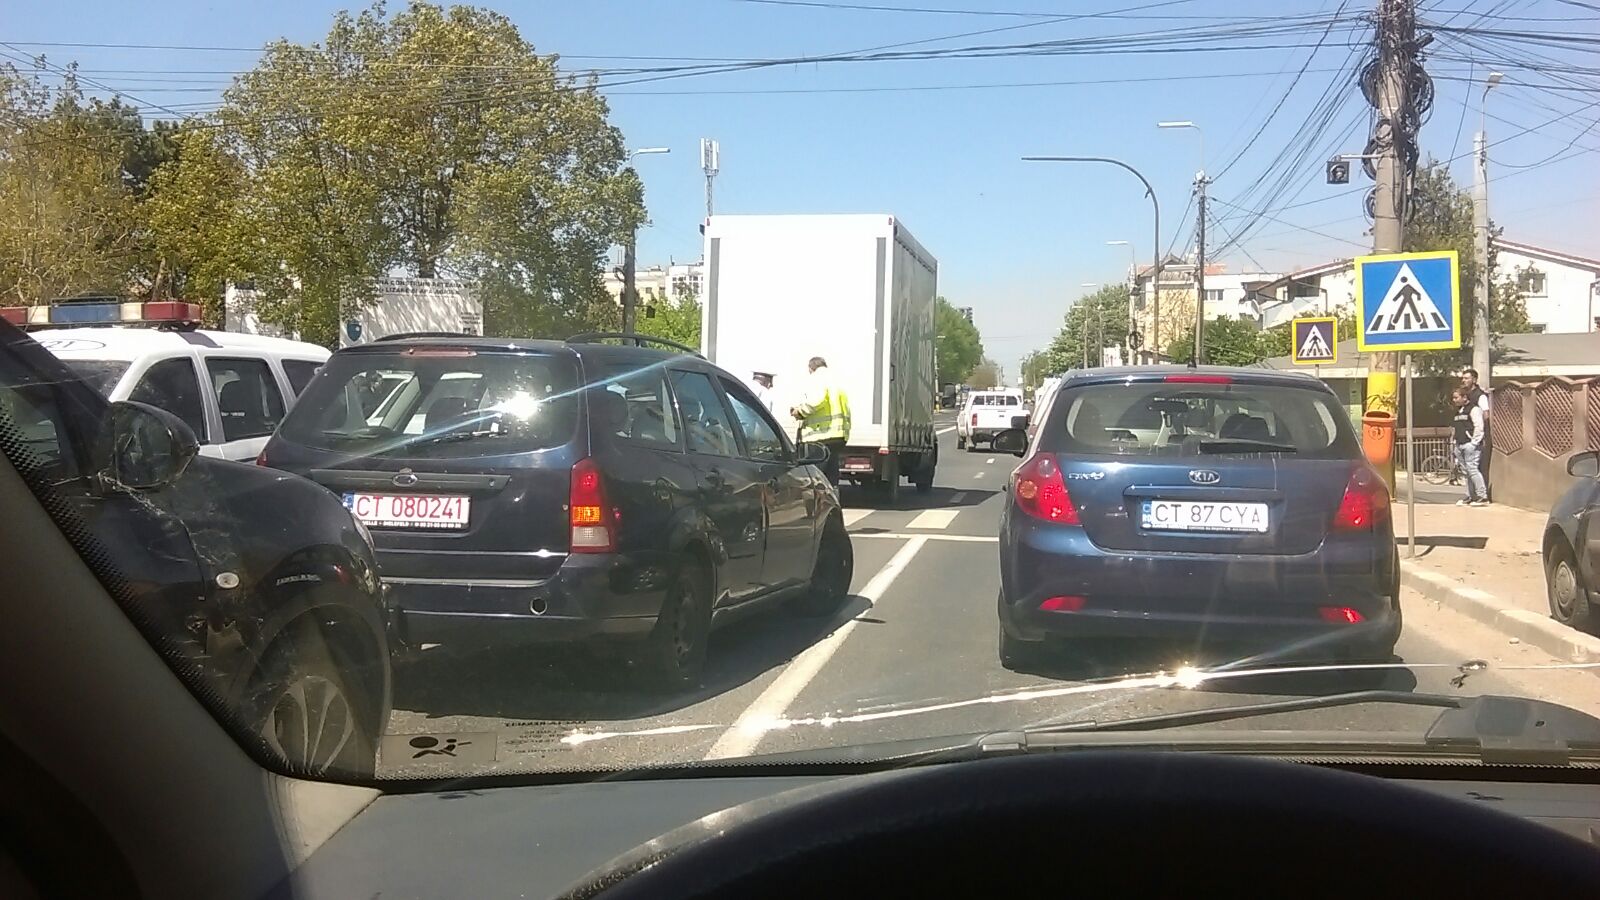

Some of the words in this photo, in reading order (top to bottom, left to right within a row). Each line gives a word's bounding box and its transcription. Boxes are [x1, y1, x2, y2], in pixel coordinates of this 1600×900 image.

[1192, 471, 1217, 482] KIA
[356, 495, 383, 517] CT
[391, 496, 462, 519] 080241
[1155, 504, 1181, 522] CT
[1191, 505, 1214, 523] 87
[1219, 505, 1260, 524] CYA
